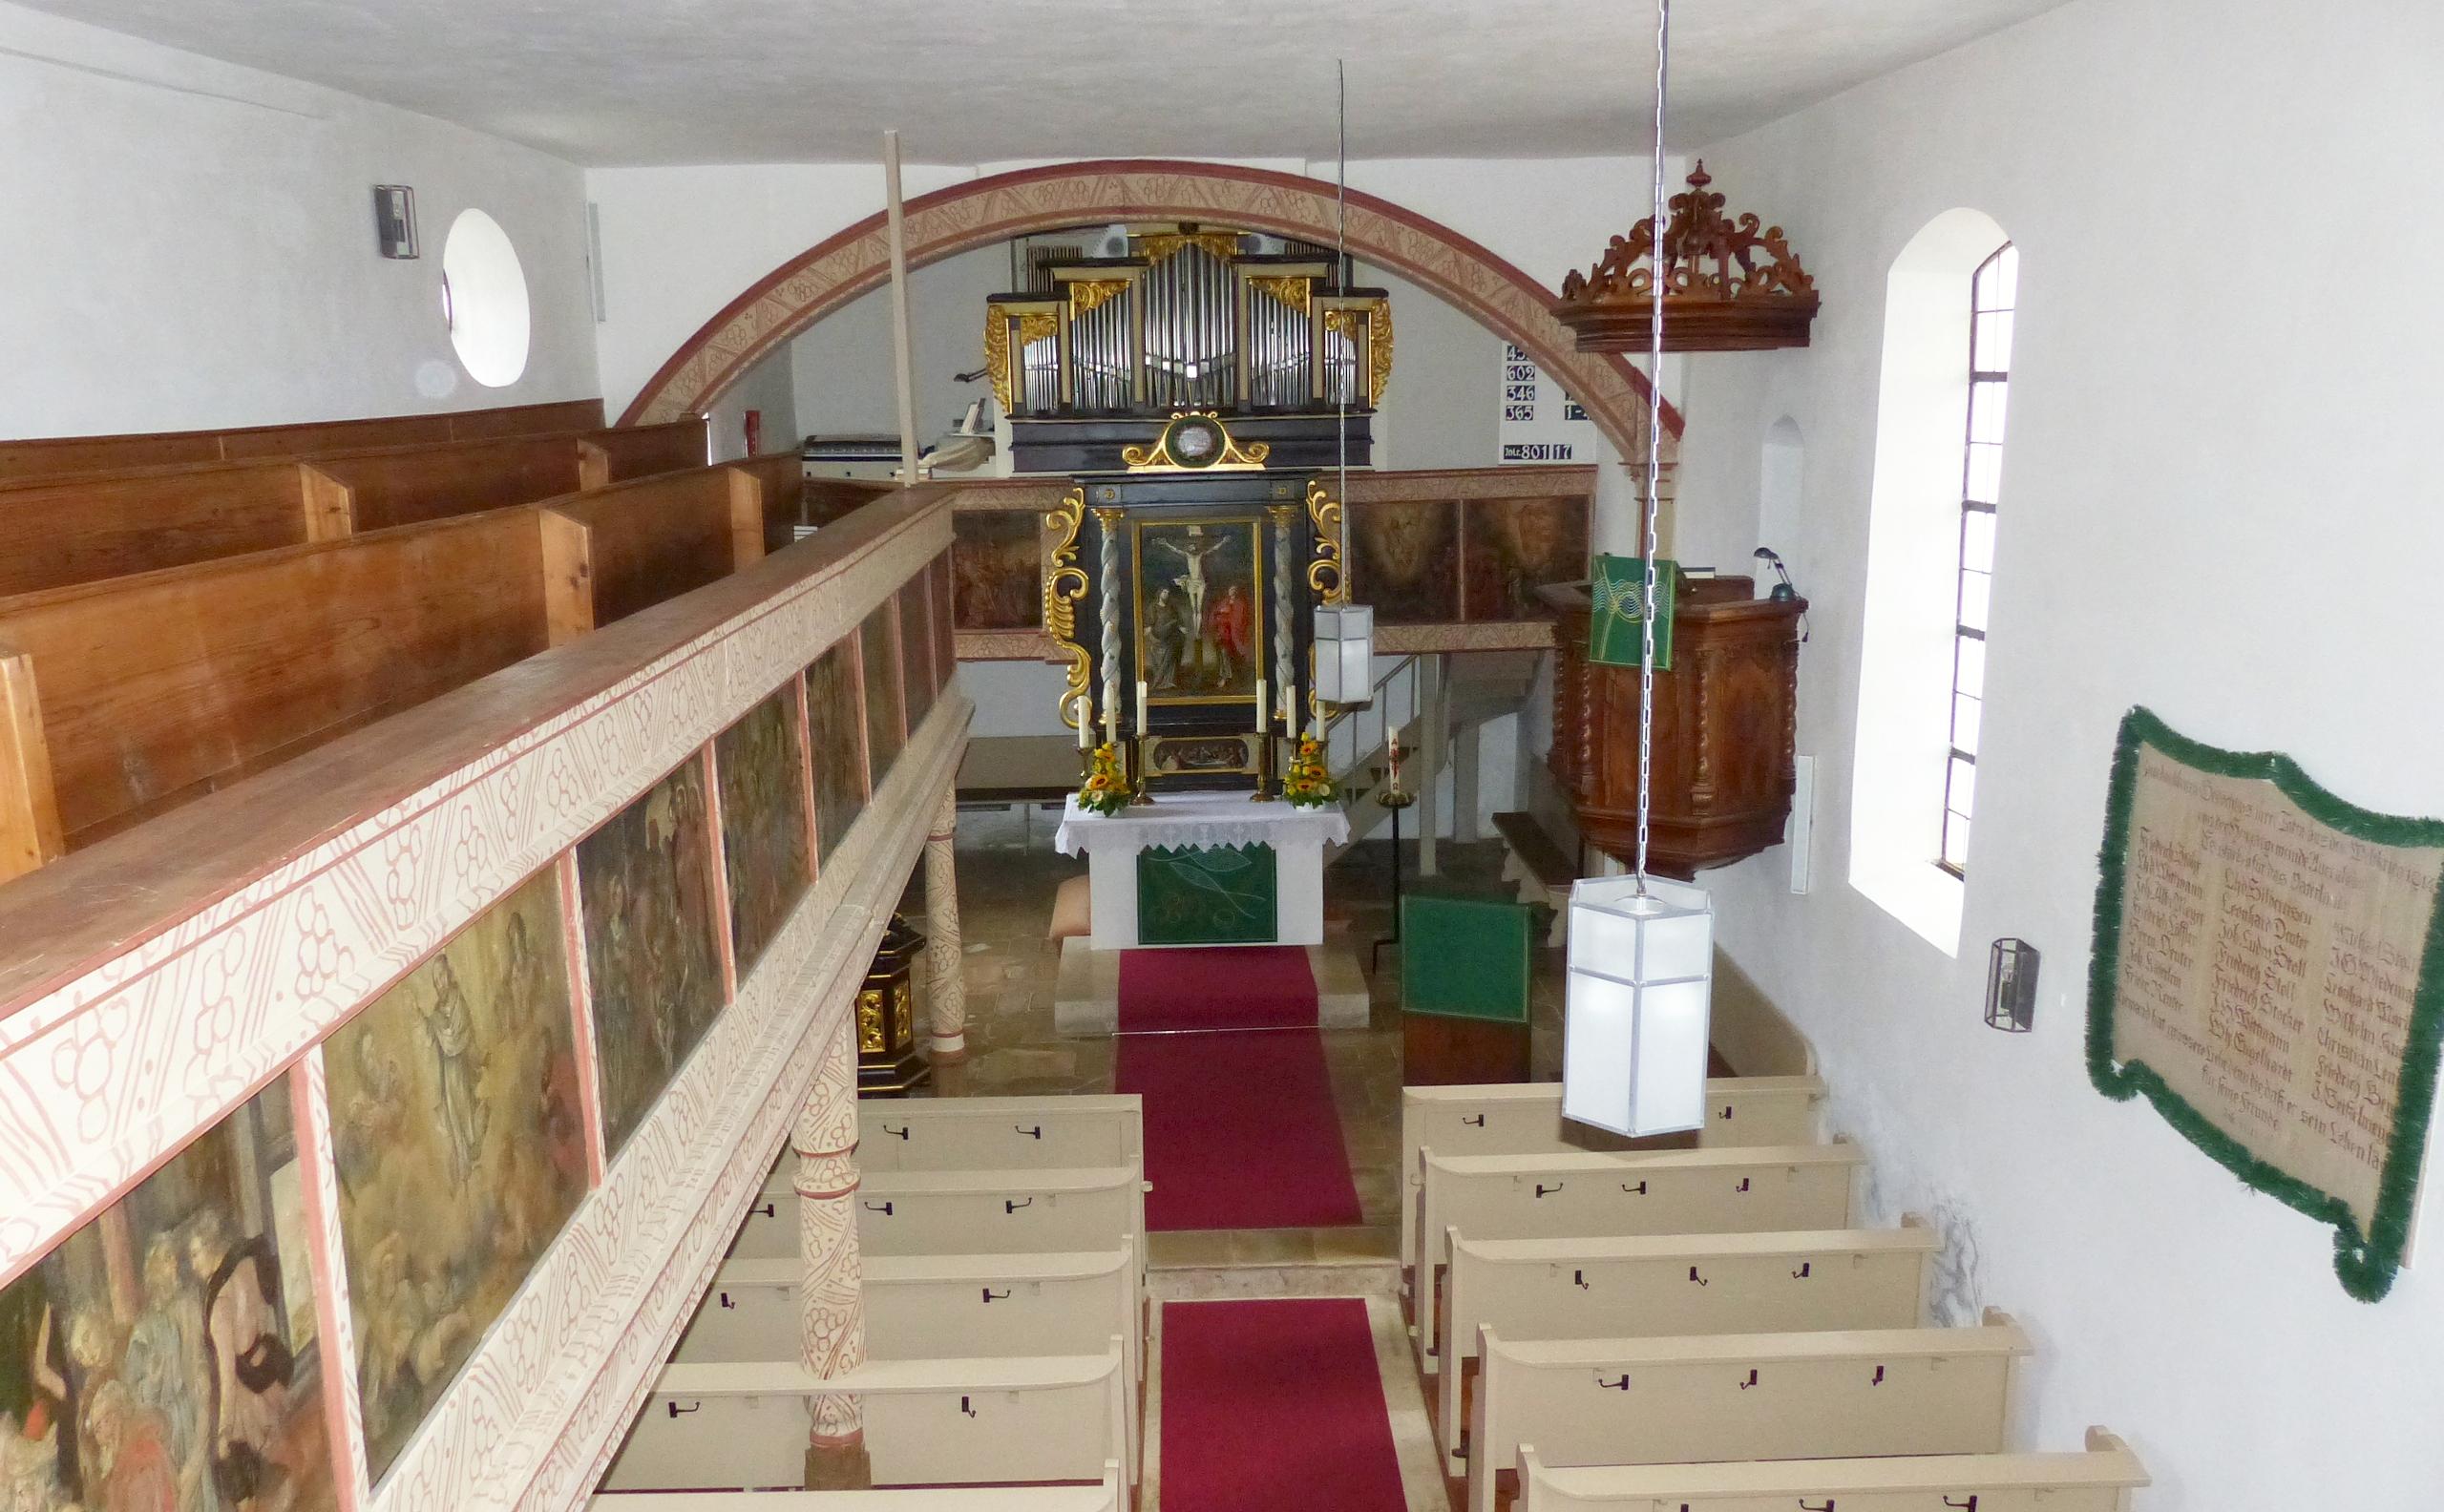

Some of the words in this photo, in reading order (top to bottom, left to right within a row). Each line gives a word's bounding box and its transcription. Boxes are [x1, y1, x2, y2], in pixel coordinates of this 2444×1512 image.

[1507, 367, 1534, 381] 602
[1507, 386, 1534, 400] 346
[1506, 406, 1533, 420] 365
[1521, 445, 1548, 459] 801
